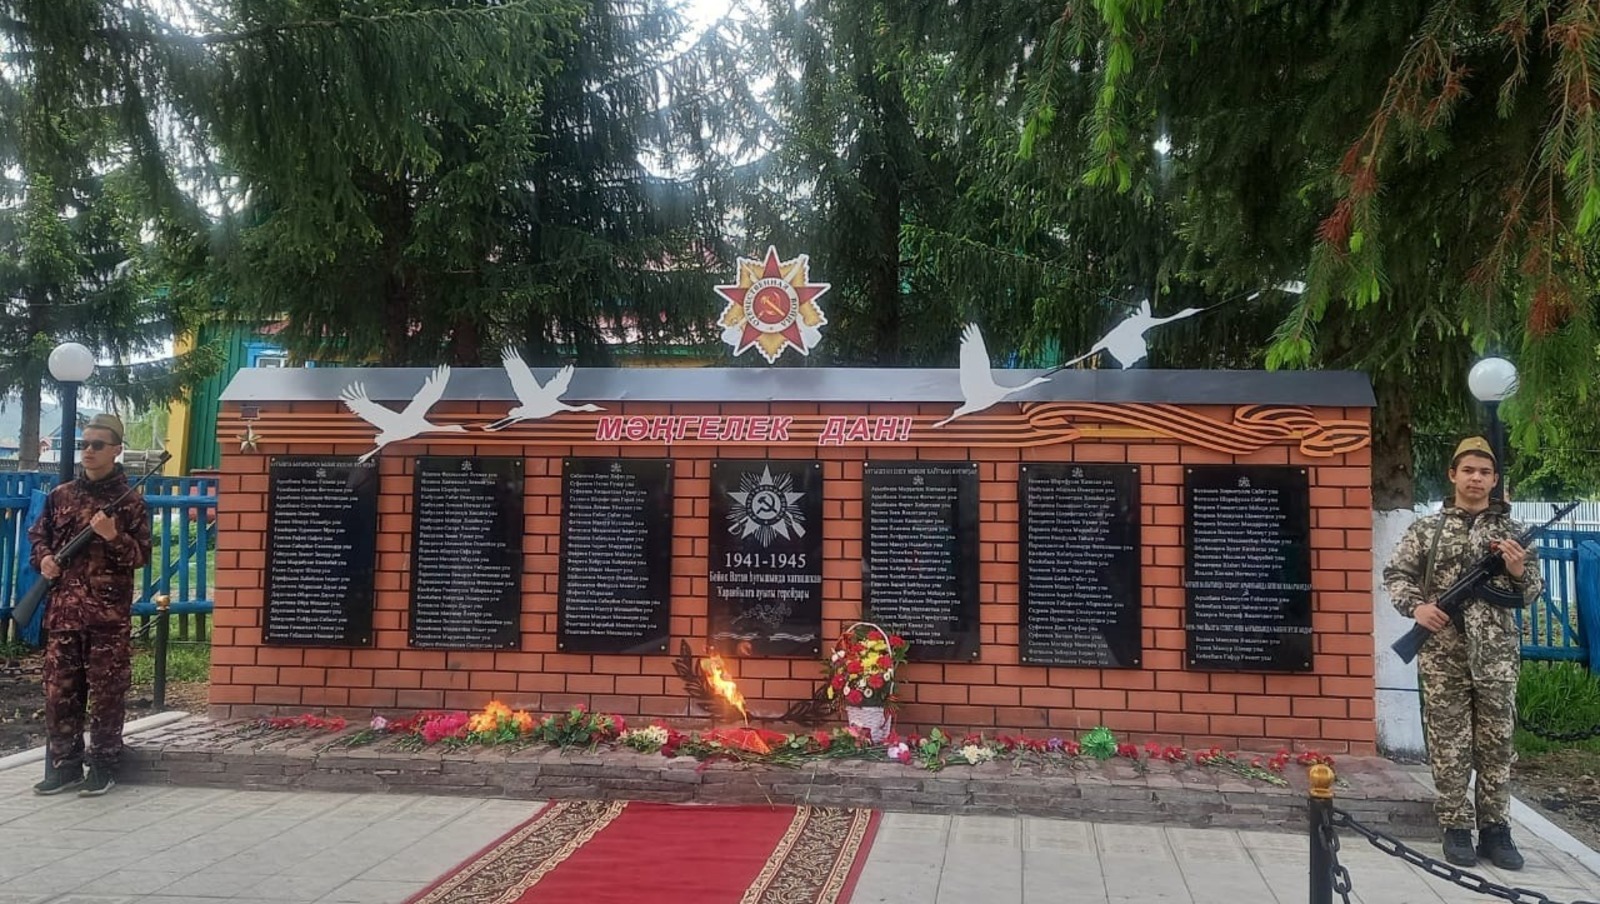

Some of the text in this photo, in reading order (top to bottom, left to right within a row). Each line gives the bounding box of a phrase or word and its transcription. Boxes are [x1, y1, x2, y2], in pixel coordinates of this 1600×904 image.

[745, 278, 789, 327] ОТЕЧЕСТВЕННАЯ
[596, 416, 911, 445] МӘҢГЕЛЕК ДАН!
[725, 552, 806, 568] 1941-1945
